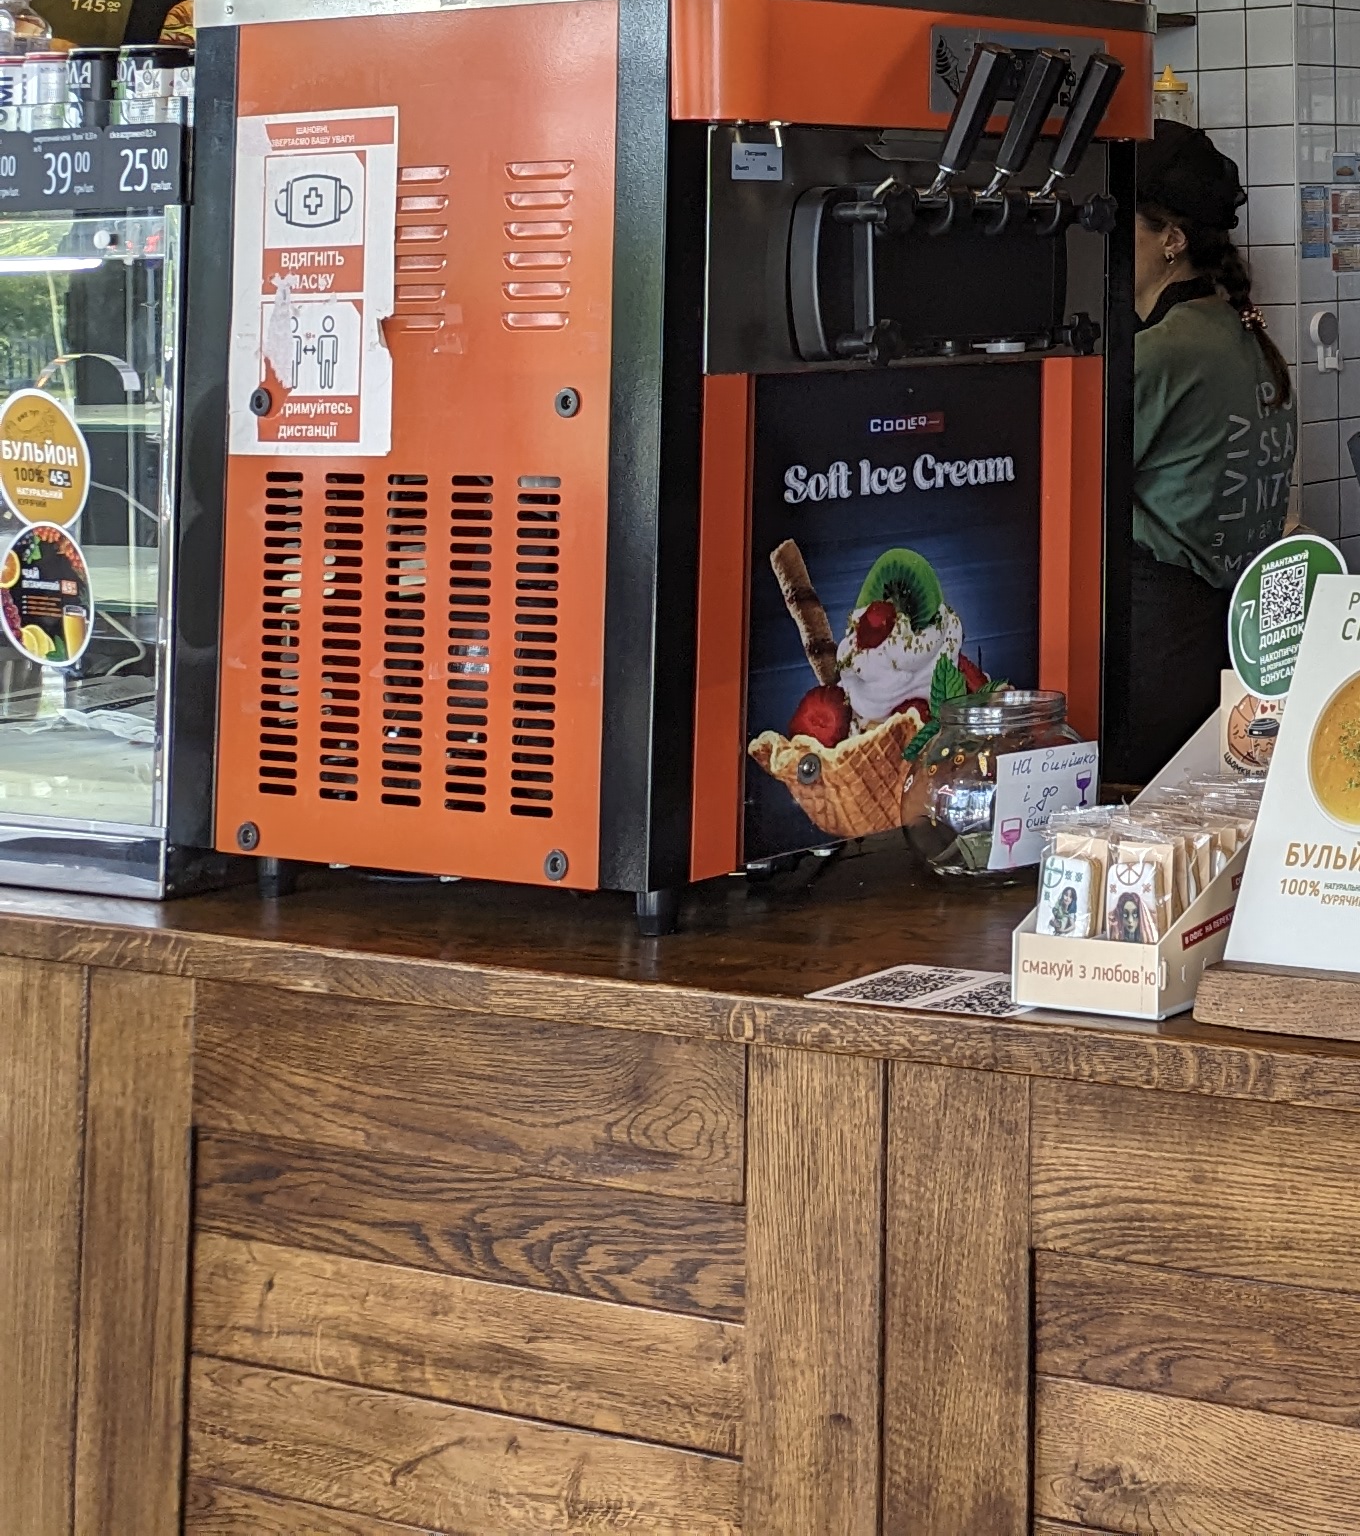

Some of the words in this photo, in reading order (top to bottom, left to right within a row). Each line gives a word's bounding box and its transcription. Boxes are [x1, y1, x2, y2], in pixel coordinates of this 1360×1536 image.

[43, 151, 72, 195] 39
[75, 150, 91, 172] 00
[119, 148, 148, 192] 25
[152, 148, 168, 170] 00
[281, 250, 344, 269] ВДЯГНІТЬ
[277, 422, 338, 439] дистанції
[1, 439, 78, 467] БУЛЬЙОН
[14, 467, 45, 484] 100%
[784, 461, 852, 504] Soft
[859, 459, 907, 496] Ice
[913, 453, 1015, 490] Cream
[1280, 878, 1320, 897] 100%
[1022, 958, 1073, 985] смакуй
[1079, 965, 1087, 978] з
